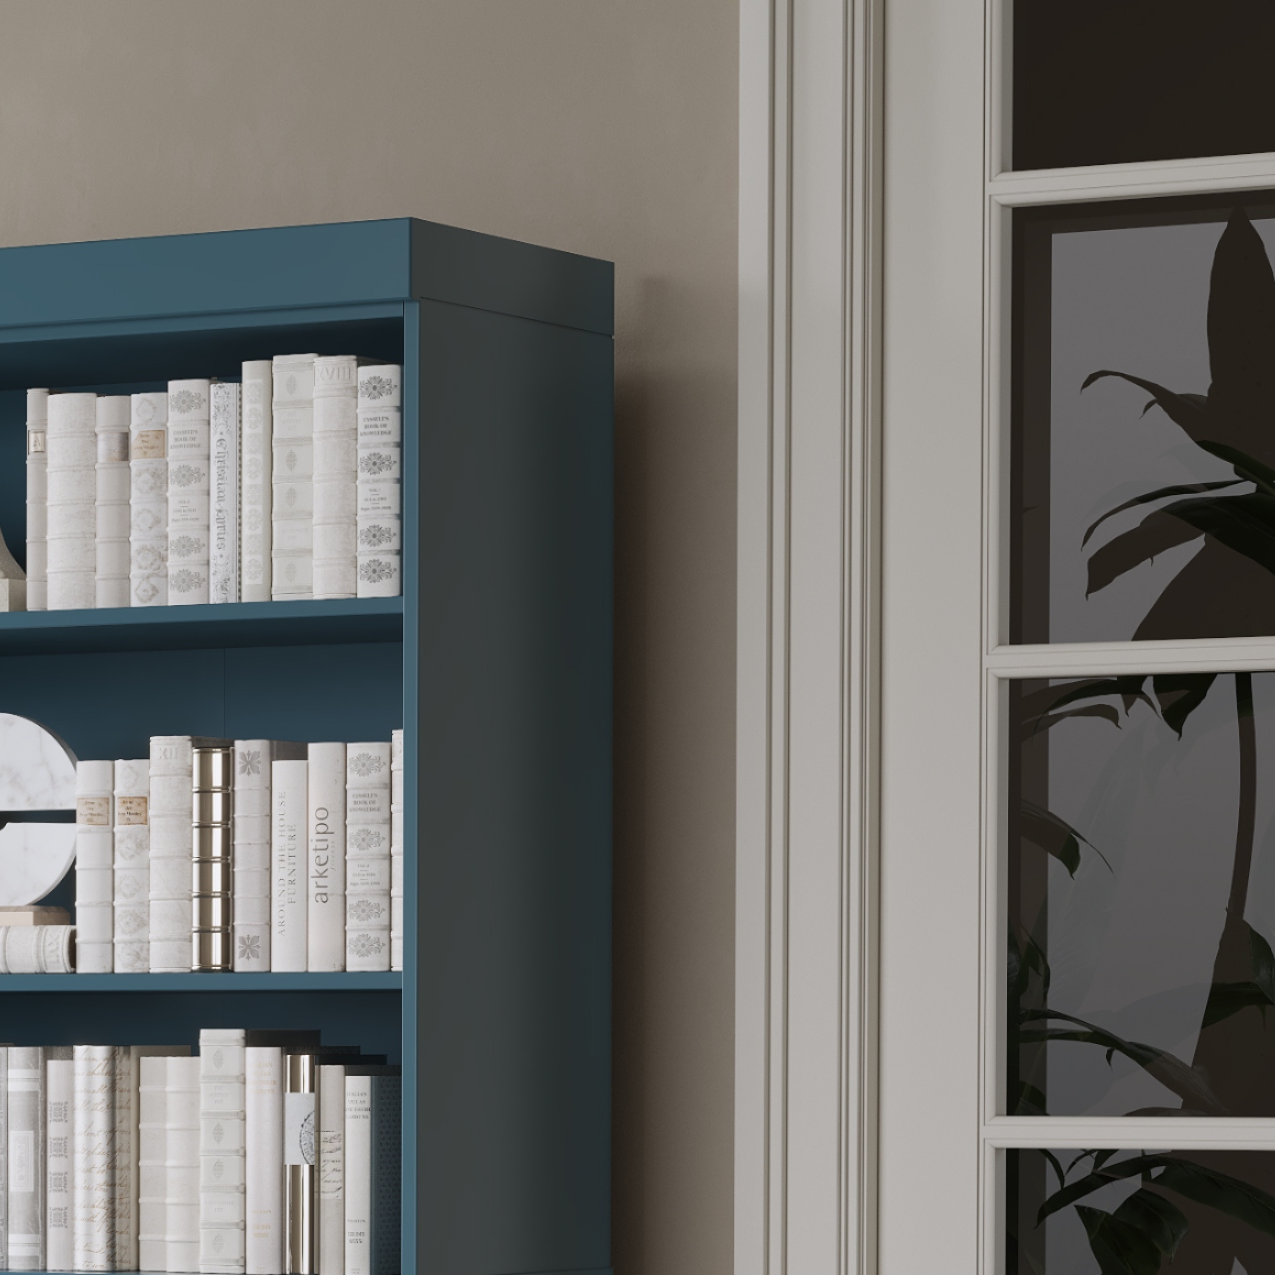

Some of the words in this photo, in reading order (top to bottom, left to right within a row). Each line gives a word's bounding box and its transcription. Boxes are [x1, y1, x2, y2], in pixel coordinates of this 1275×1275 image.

[277, 790, 287, 838] HOUSE
[277, 844, 287, 872] THE
[287, 823, 297, 905] FURNITURE
[310, 806, 335, 904] arketipo
[277, 877, 287, 938] AROUND
